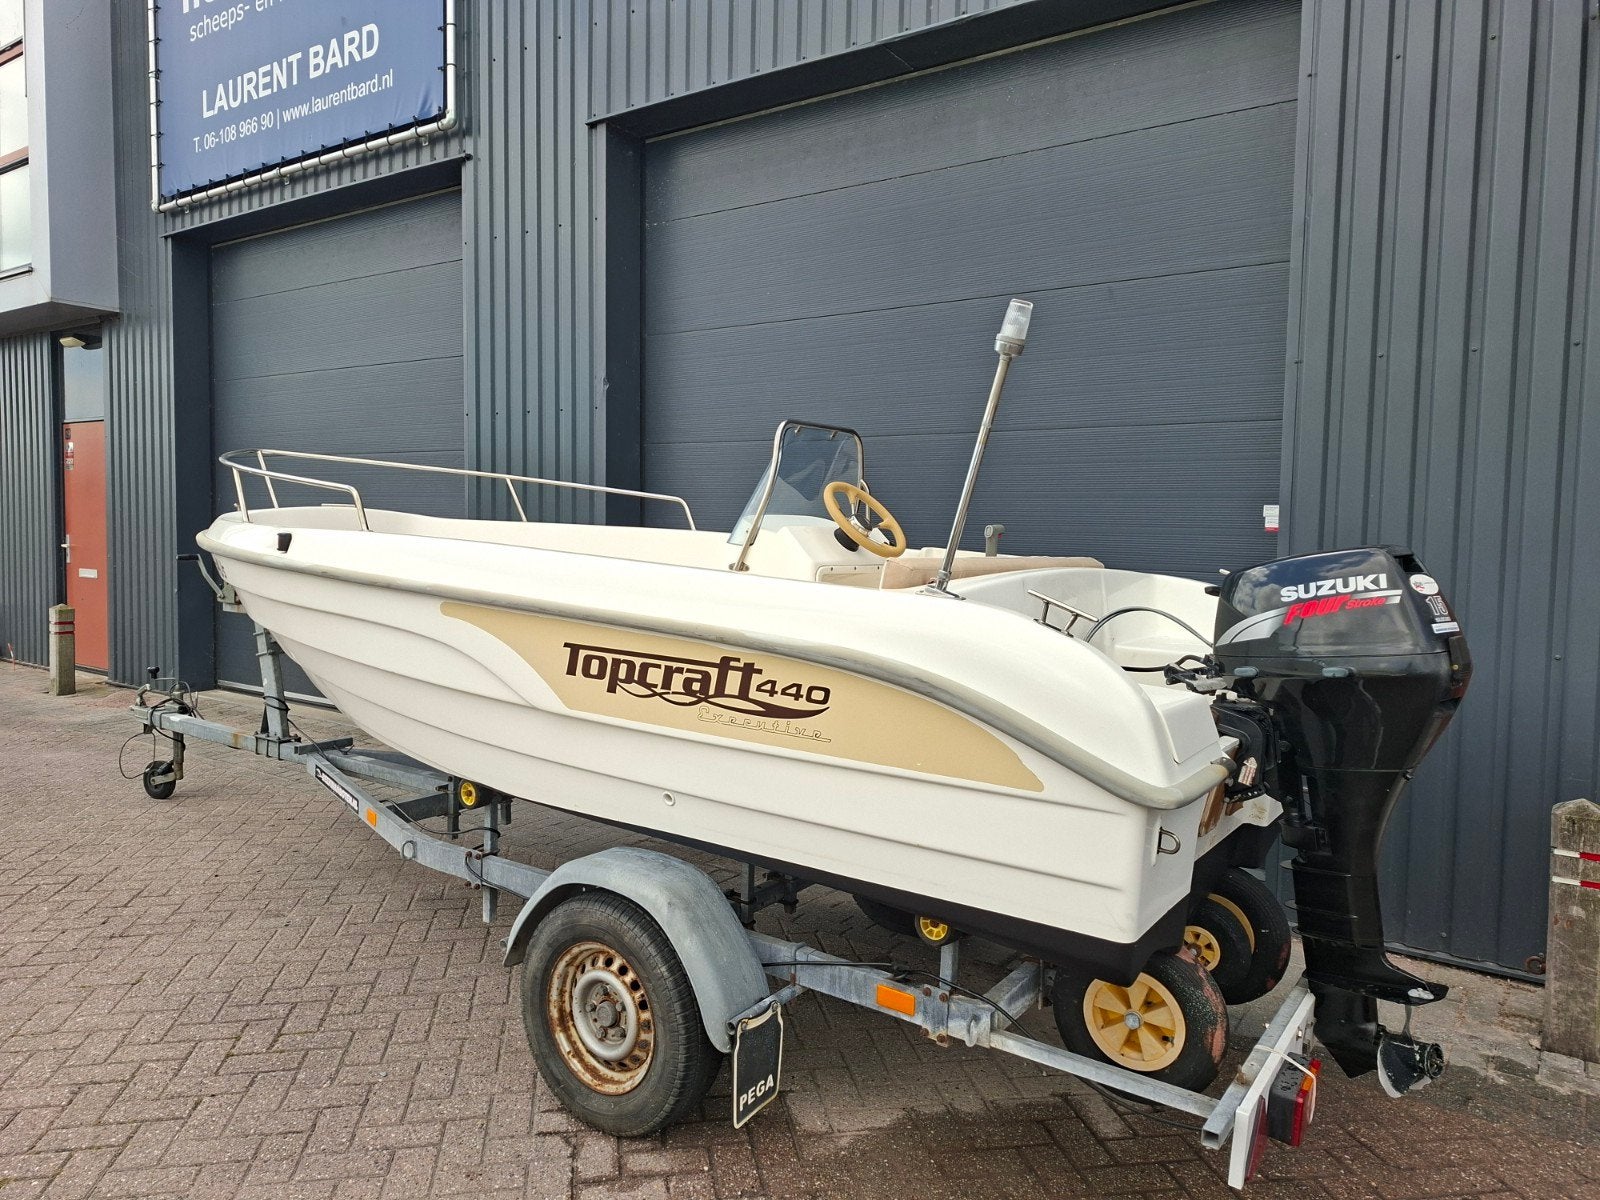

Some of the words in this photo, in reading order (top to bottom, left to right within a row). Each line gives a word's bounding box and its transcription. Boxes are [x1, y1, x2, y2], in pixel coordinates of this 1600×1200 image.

[190, 3, 250, 42] scheeps-
[202, 52, 302, 119] LAURENT
[309, 23, 380, 79] BARD
[193, 136, 202, 153] T.
[203, 124, 237, 150] 06-108
[239, 116, 258, 138] 966
[260, 111, 274, 131] 90
[282, 68, 394, 123] www.laurentbard.nl
[1280, 573, 1388, 602] SUZUKI
[1425, 595, 1449, 616] 15
[563, 642, 763, 703] Topcraft
[756, 679, 831, 705] 440
[697, 705, 832, 743] Executive
[739, 1073, 775, 1112] PEGA
